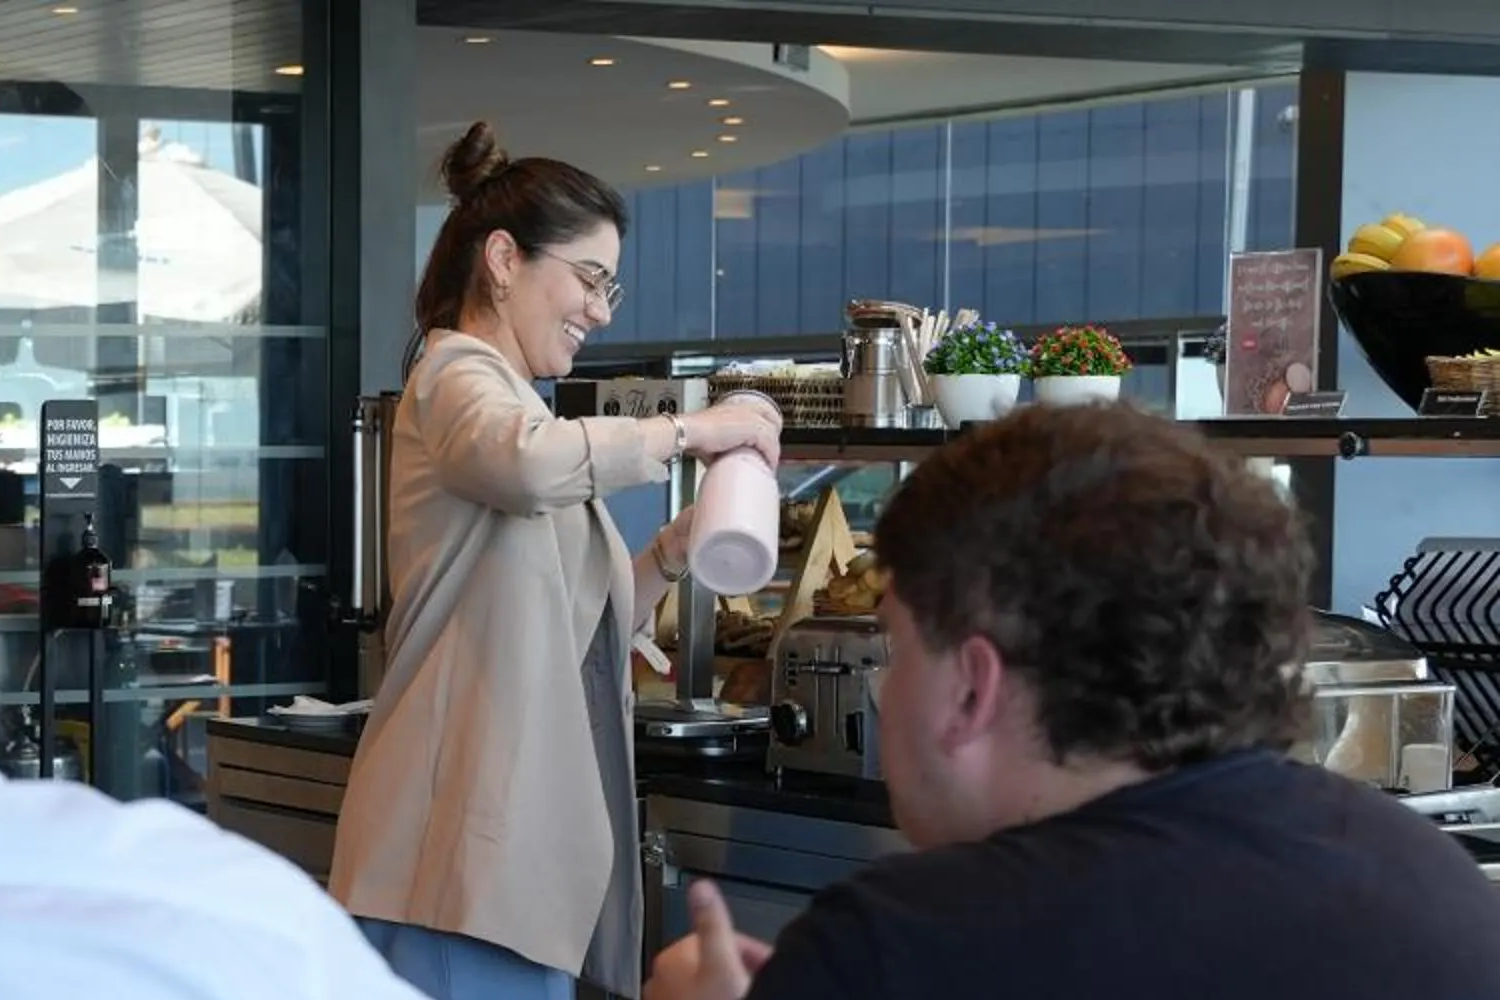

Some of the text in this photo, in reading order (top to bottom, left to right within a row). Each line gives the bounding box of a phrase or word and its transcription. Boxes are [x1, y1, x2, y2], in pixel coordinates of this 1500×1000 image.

[47, 419, 65, 431] POR
[47, 433, 97, 446] HIGIENIZA
[47, 449, 97, 461] TUS MANOS
